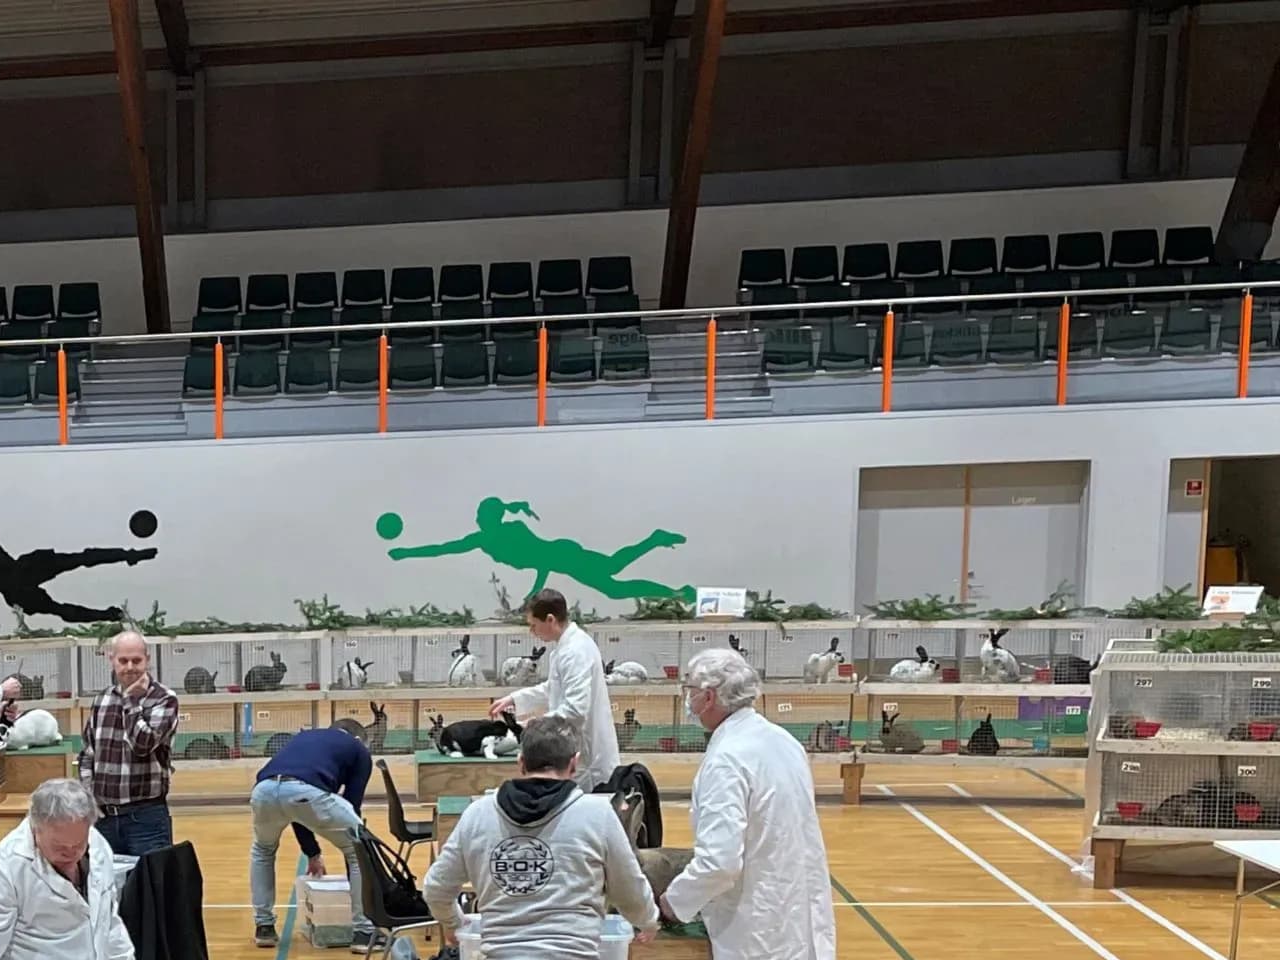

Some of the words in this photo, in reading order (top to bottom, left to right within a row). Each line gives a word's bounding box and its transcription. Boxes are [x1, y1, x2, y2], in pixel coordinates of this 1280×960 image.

[1136, 679, 1152, 687] 297
[1253, 680, 1271, 688] 299
[1239, 768, 1256, 776] 300
